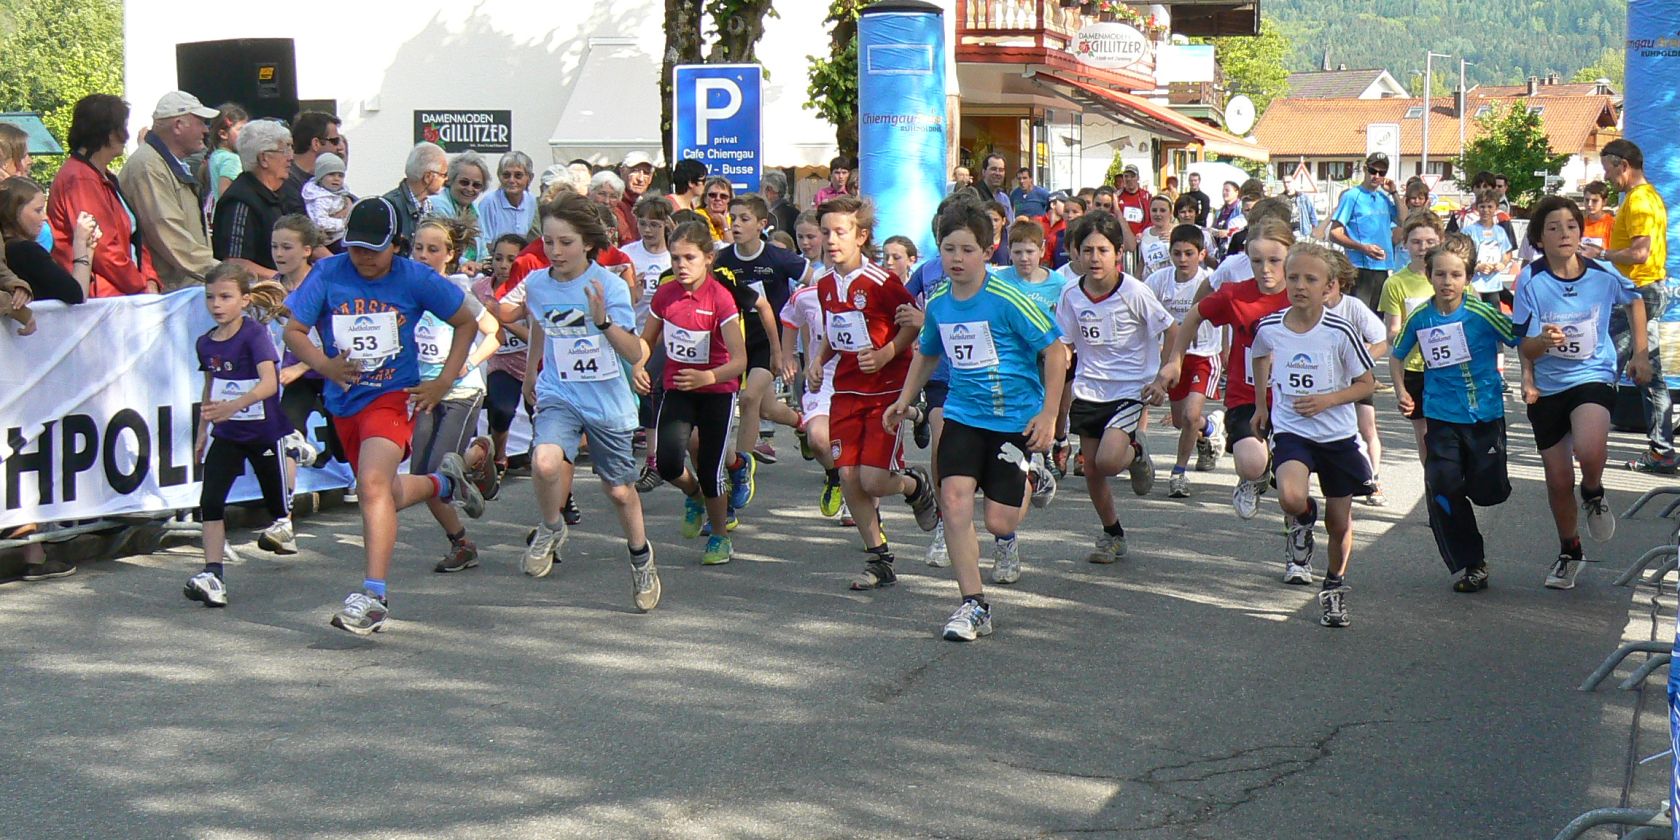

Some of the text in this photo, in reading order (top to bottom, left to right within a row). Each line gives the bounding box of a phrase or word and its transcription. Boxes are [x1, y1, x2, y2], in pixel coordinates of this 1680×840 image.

[1091, 40, 1141, 53] GILLITZER
[422, 114, 494, 123] DAMENMODEN
[696, 78, 742, 145] P
[440, 124, 508, 142] GILLITZER
[714, 136, 738, 145] privat
[683, 149, 754, 160] Cafe Chiemgau
[722, 164, 754, 174] Busse
[1148, 251, 1164, 261] 143
[353, 336, 378, 351] 53
[837, 331, 854, 344] 42
[668, 341, 697, 358] 126
[954, 345, 973, 360] 57
[1431, 345, 1451, 361] 55
[573, 358, 598, 373] 44
[1289, 373, 1314, 389] 56
